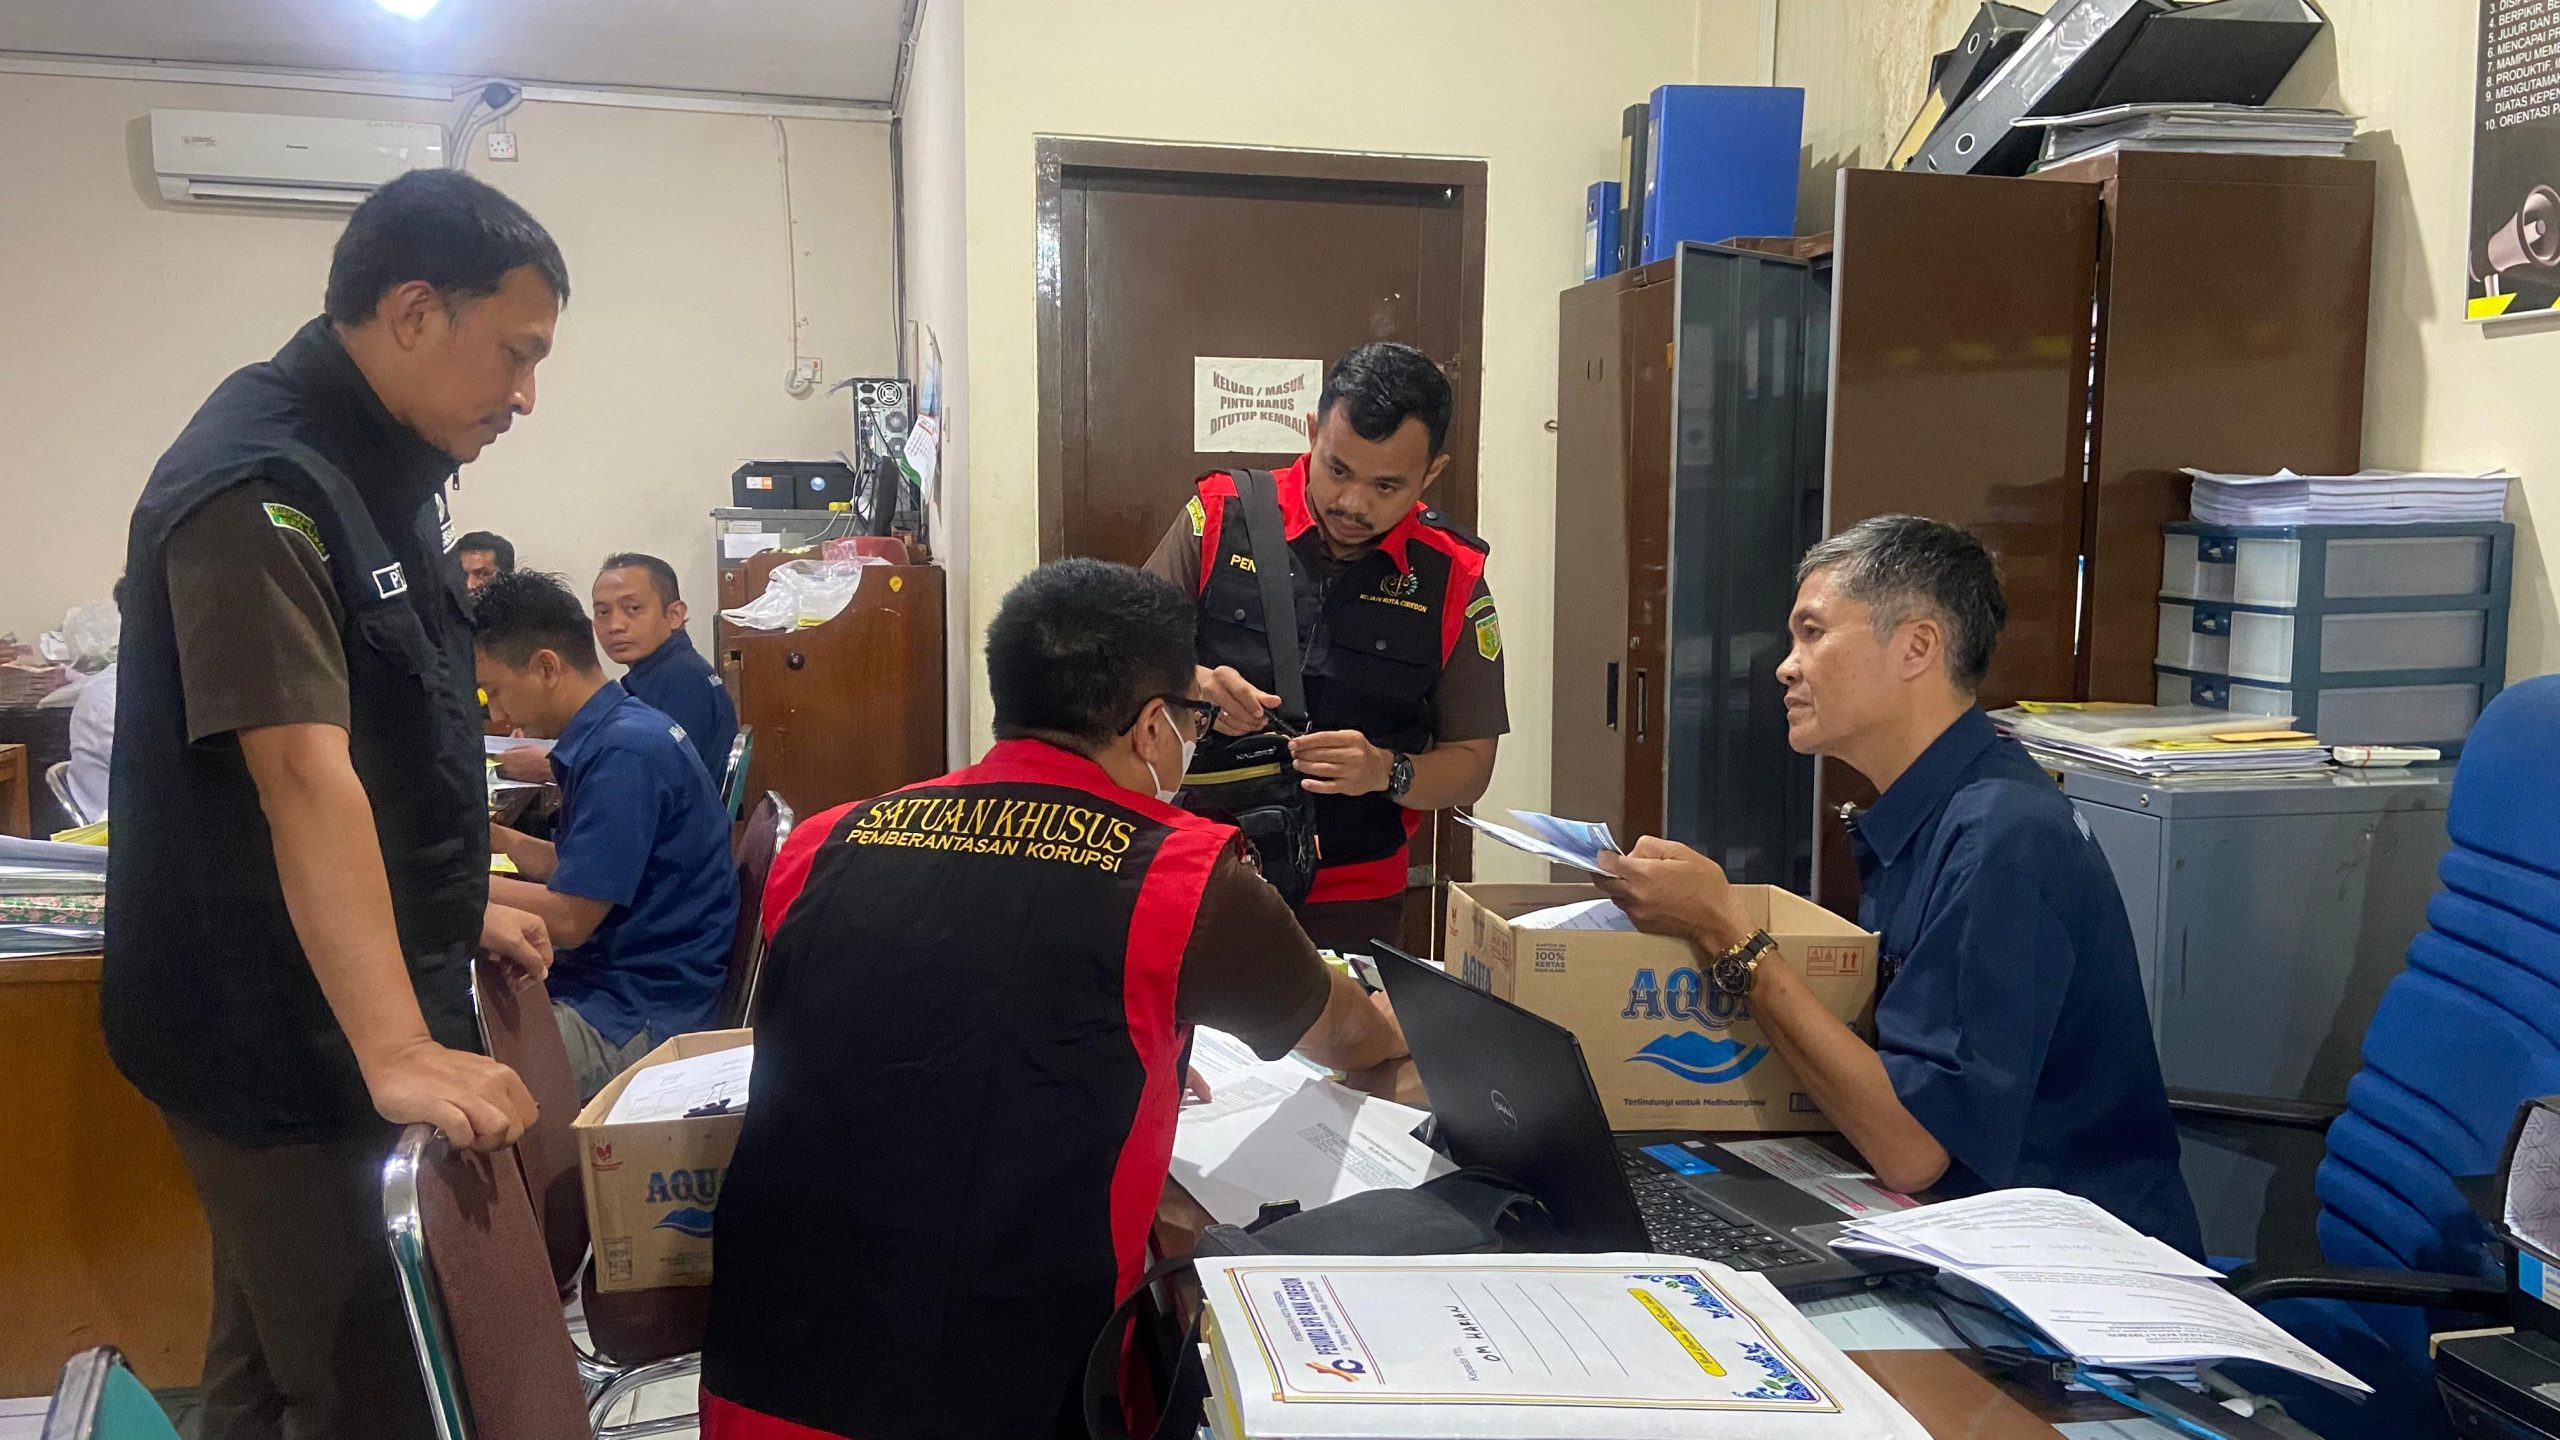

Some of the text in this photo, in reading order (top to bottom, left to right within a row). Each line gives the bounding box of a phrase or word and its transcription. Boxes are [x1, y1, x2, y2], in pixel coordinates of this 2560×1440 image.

[2498, 22, 2528, 41] JUJUR
[2530, 15, 2551, 31] DAN
[2497, 31, 2546, 55] MENCAPAI
[2496, 50, 2532, 70] MAMPU
[2495, 95, 2528, 114] DIATAS
[2485, 118, 2497, 131] 10.
[2499, 105, 2551, 127] ORIENTASI
[1213, 371, 1254, 396] KELUAR
[1265, 373, 1305, 397] MASUK
[1220, 396, 1295, 411] PINTU HARUS
[1210, 411, 1306, 438] DITUTUP KEMBALI
[1382, 597, 1399, 606] KOTA
[857, 798, 1136, 854] SATUAN KHUSUS
[845, 829, 1122, 873] PEMBERANTASAN KORUPSI
[1535, 952, 1566, 961] 100%
[1535, 961, 1566, 969] KERTAS
[1620, 966, 1751, 1031] AQU
[1623, 1098, 1766, 1107] Terlindungi untuk Melindungimu
[1280, 1277, 1310, 1301] CIREBON
[1291, 1301, 1318, 1316] BANK
[1299, 1316, 1325, 1328] BPR
[1306, 1328, 1340, 1355] PERUMDA
